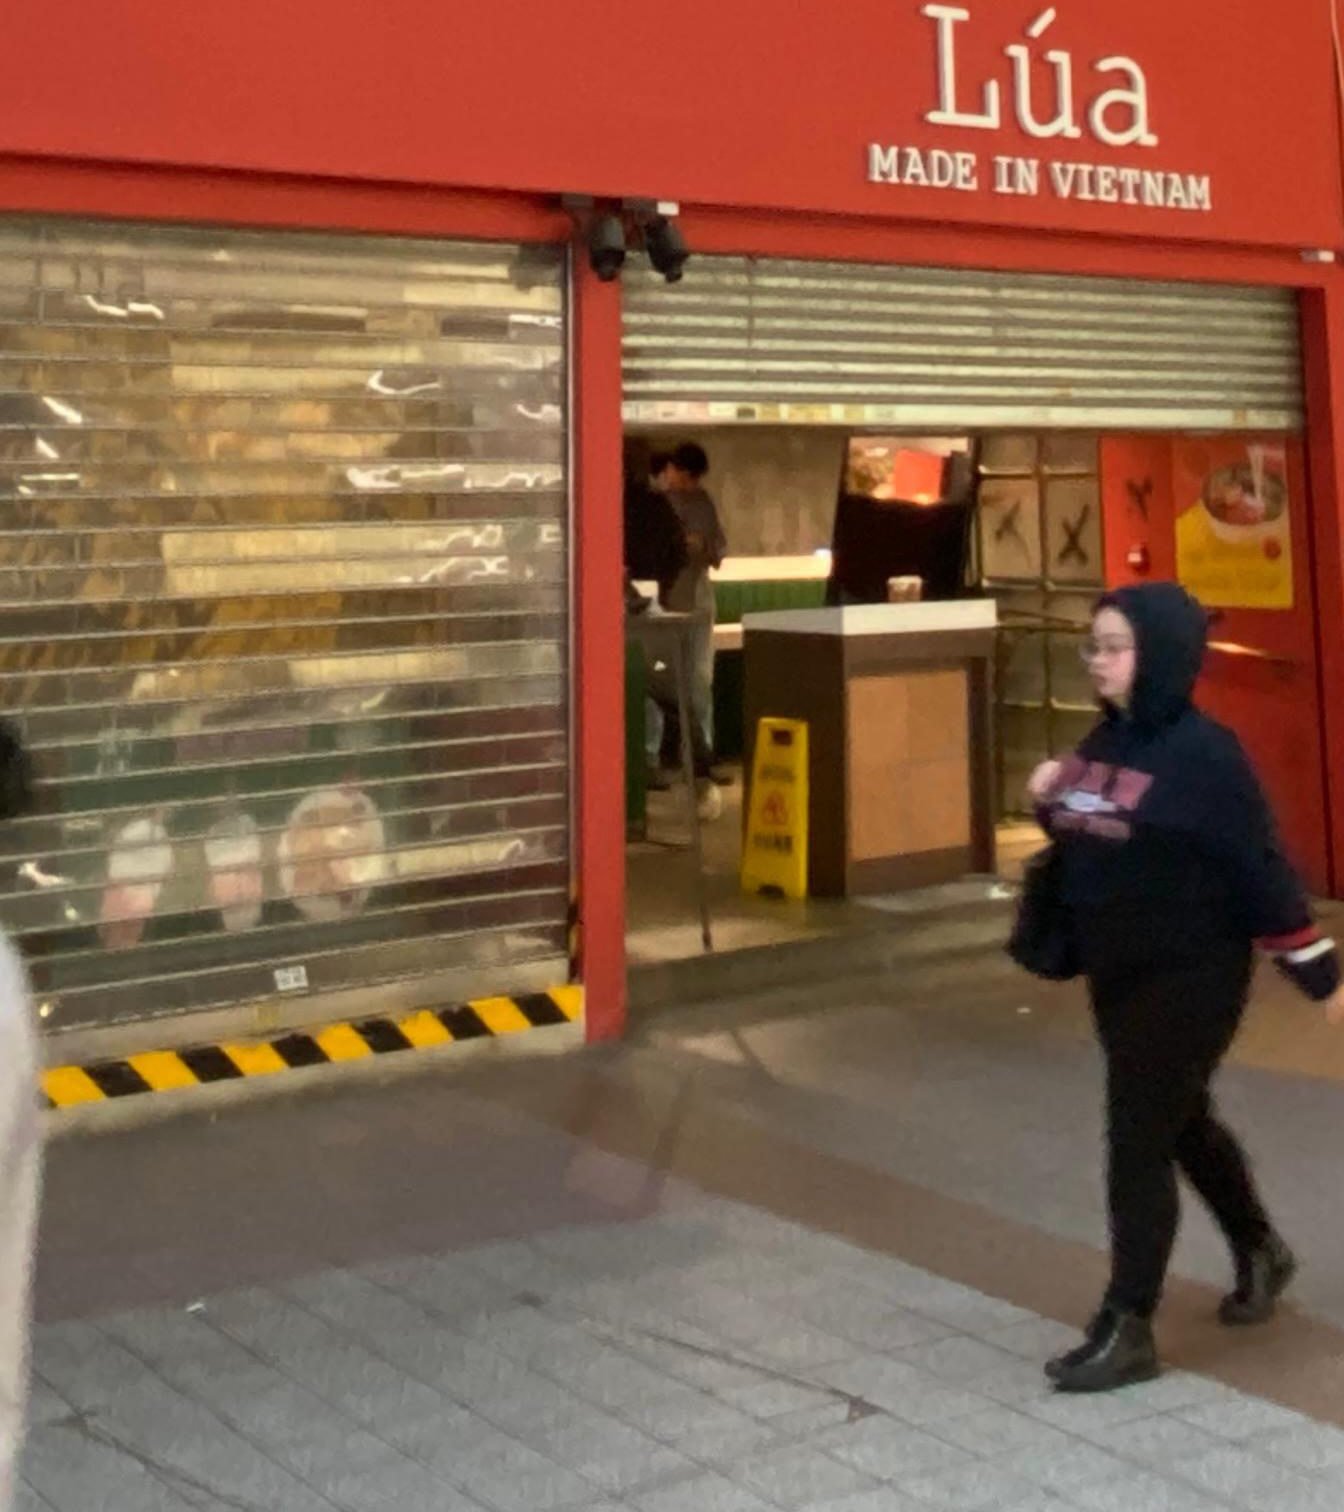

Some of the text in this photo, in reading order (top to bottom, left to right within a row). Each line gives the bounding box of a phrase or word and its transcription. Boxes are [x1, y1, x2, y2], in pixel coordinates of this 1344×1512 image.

[921, 3, 1158, 147] Lúa
[868, 142, 1212, 211] MADE IN VIETNAM
